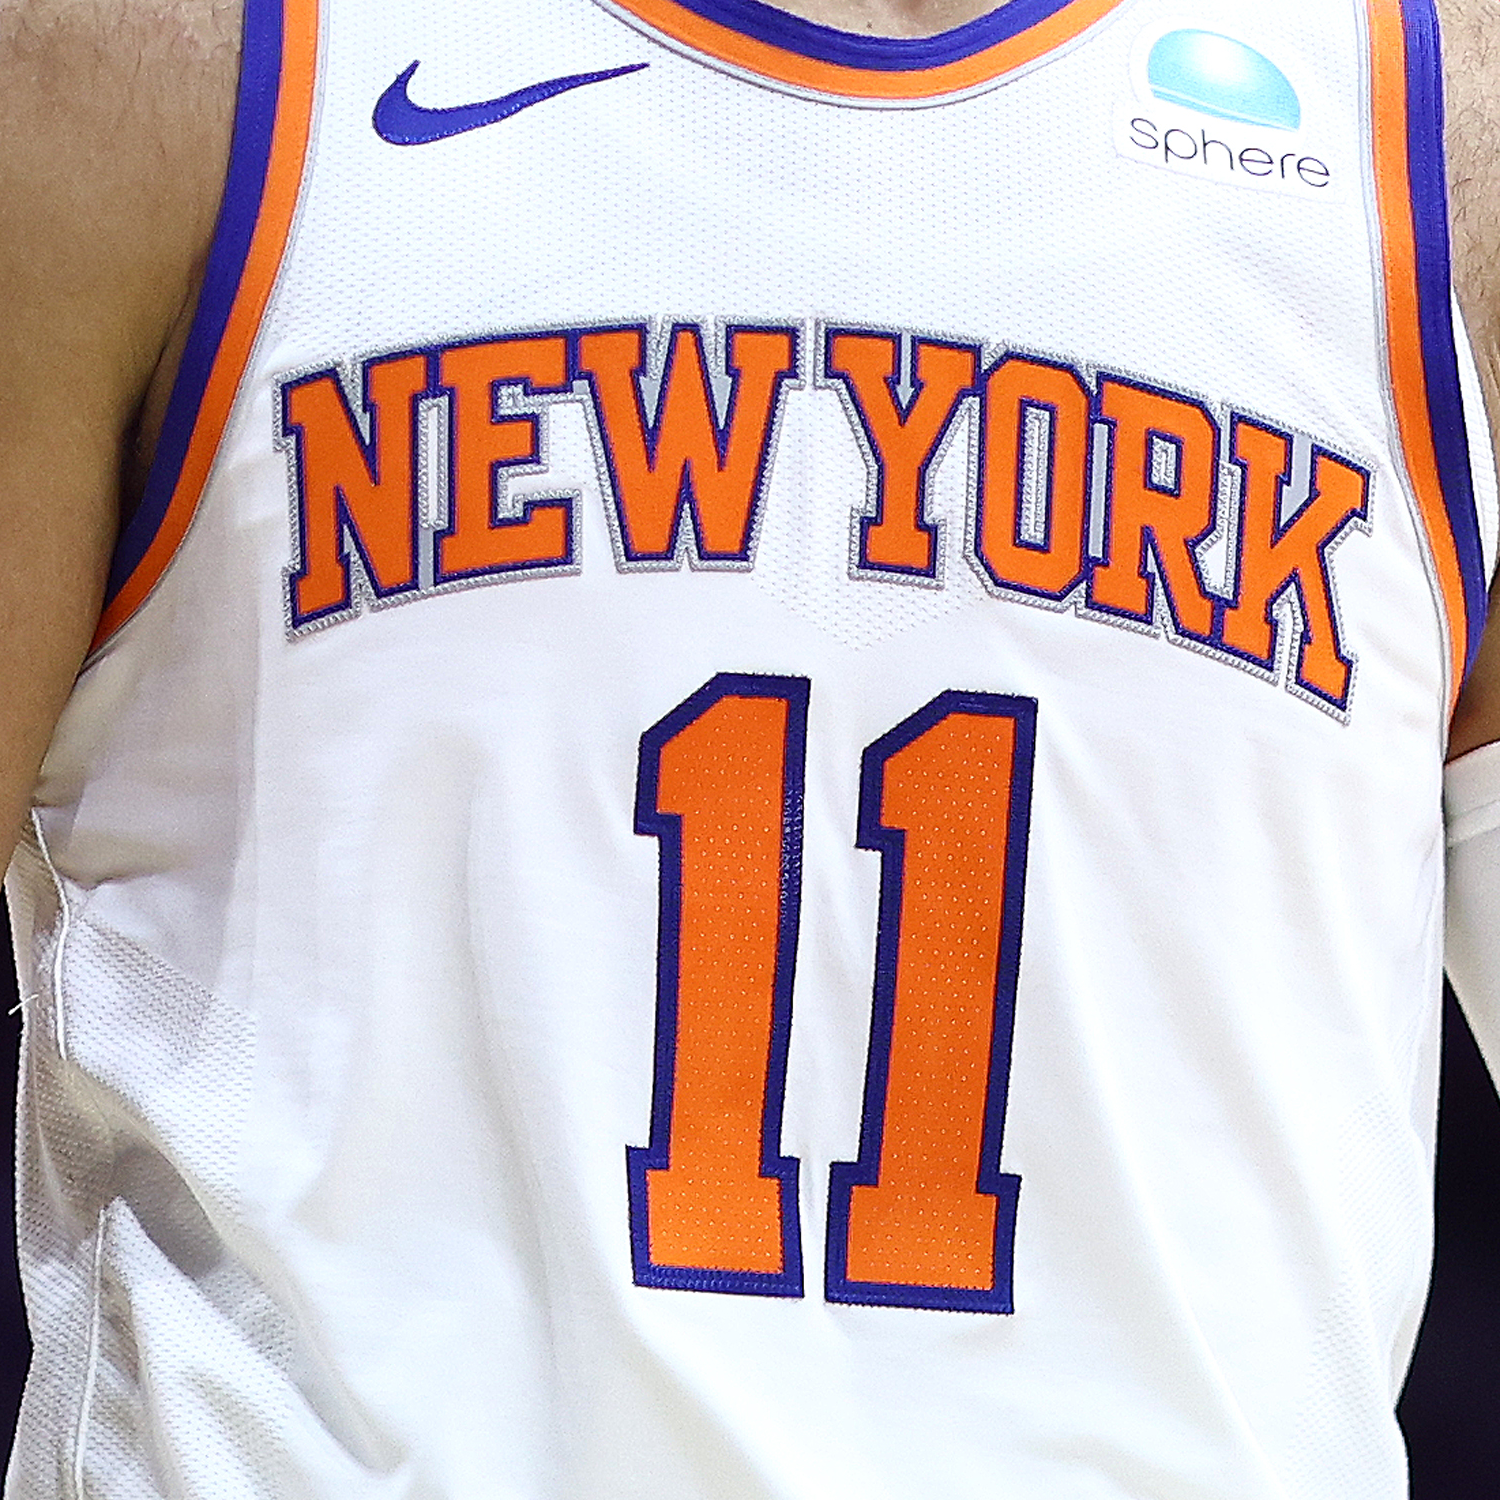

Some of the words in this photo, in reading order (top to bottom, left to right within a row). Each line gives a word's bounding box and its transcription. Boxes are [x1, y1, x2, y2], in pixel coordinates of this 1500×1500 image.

[1129, 117, 1330, 188] sphere
[274, 316, 804, 642] NEW
[814, 318, 1375, 725] YORK
[626, 672, 1038, 1315] 11
